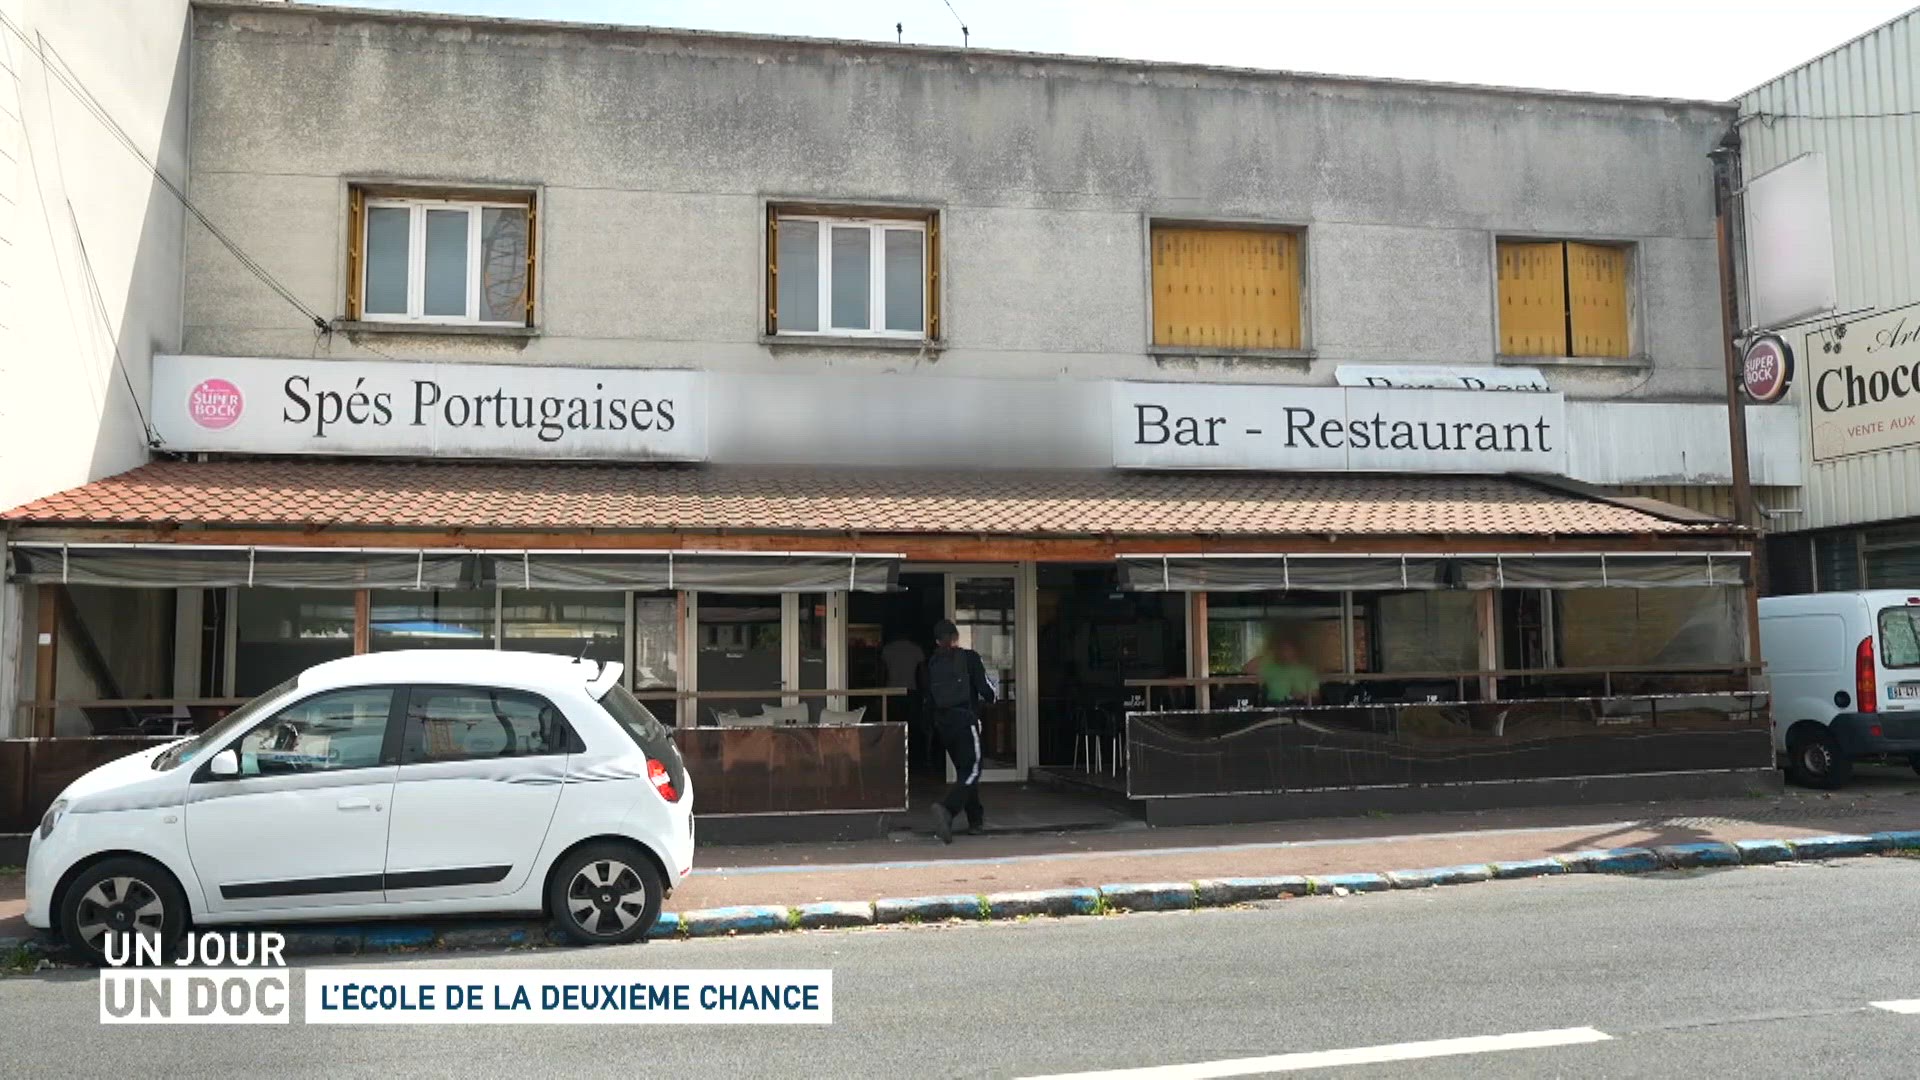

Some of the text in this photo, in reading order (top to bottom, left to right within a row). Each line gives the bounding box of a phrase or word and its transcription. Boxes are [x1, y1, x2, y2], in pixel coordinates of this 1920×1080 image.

[1745, 355, 1774, 372] SUPER
[1746, 367, 1773, 384] BOCK
[193, 391, 239, 405] SUPER
[194, 404, 236, 417] BOCK
[283, 375, 676, 443] Spés Portugaises
[1134, 404, 1227, 447] Bar
[1283, 407, 1553, 453] Restaurant
[1848, 415, 1916, 438] VENTE AUX
